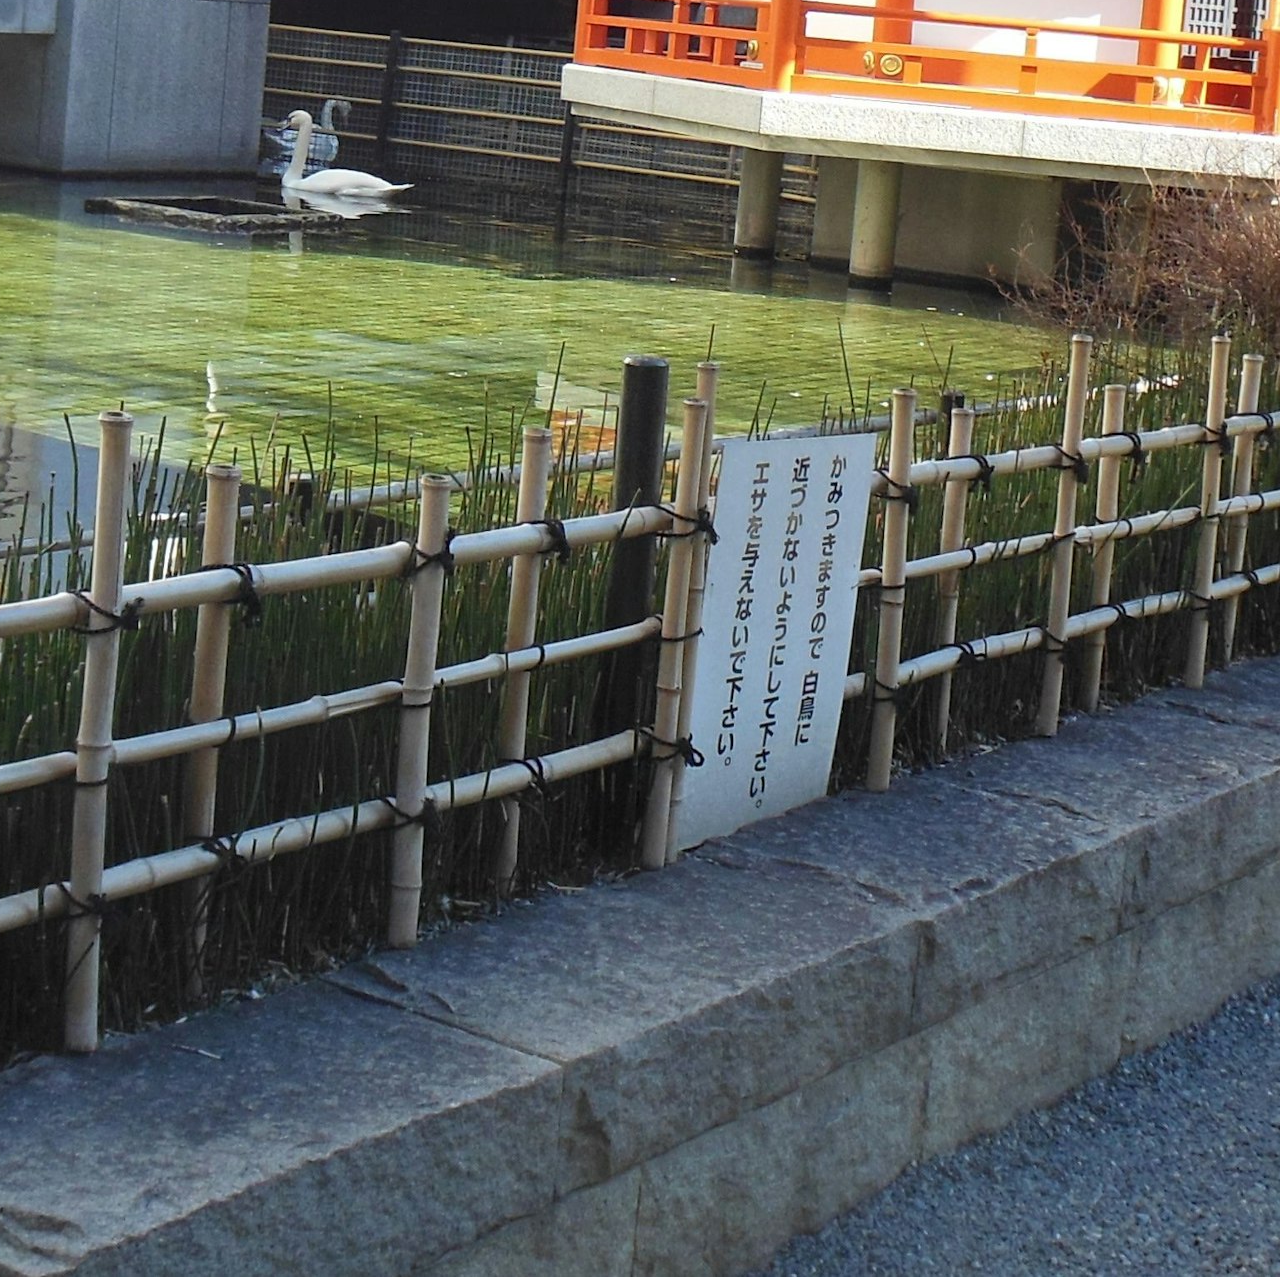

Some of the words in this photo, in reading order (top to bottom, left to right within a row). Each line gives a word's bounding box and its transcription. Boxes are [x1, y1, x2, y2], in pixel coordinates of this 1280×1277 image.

[717, 462, 770, 767] エサを与えないで下さい。
[749, 457, 811, 809] 近づかないようにして下さい。
[808, 454, 847, 660] かみつきますので
[794, 670, 818, 747] 白鳥に
